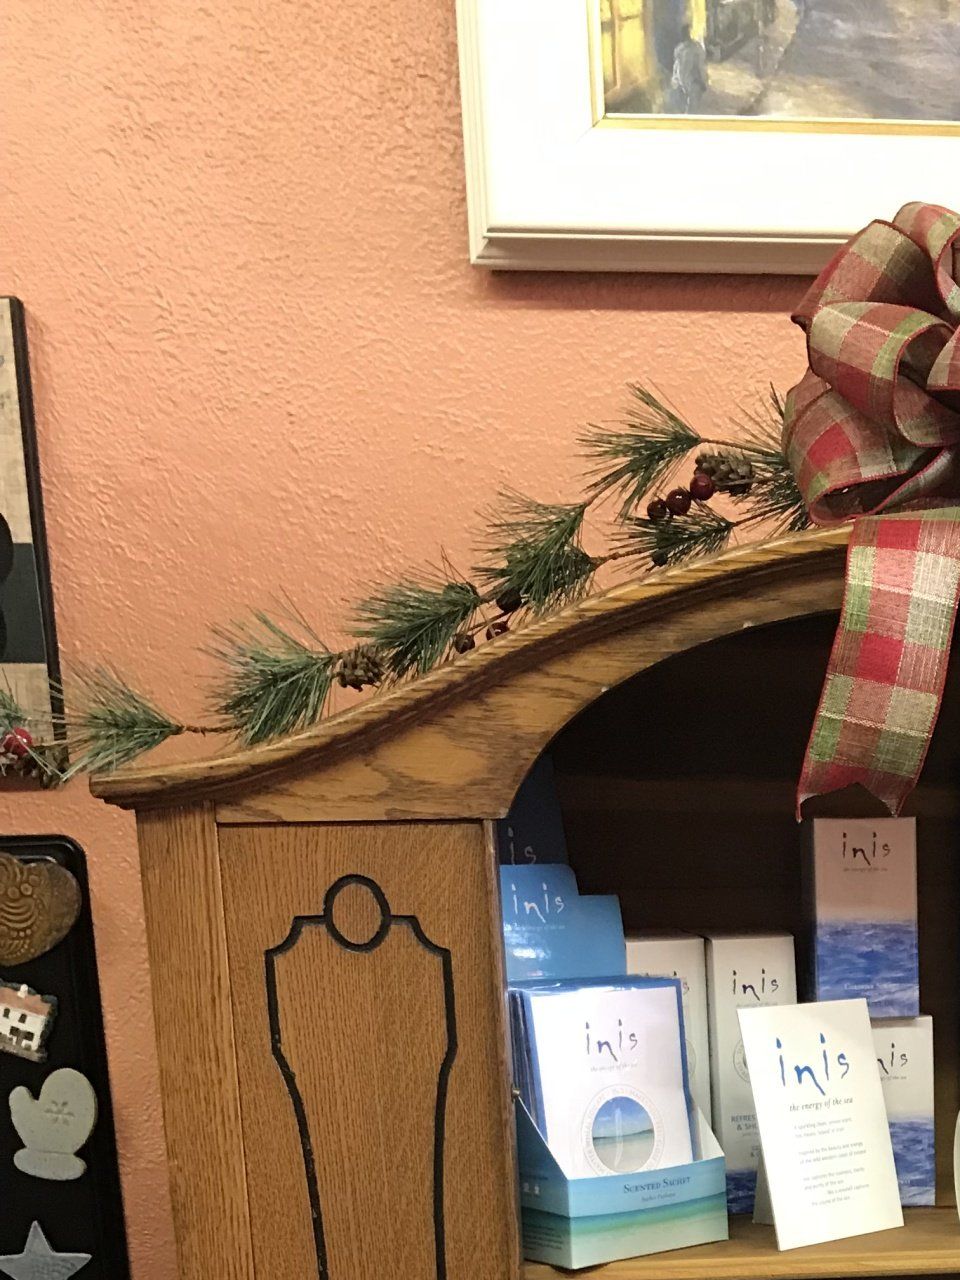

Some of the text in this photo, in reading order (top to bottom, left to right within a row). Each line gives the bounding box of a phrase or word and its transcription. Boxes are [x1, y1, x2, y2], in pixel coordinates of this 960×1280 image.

[842, 831, 891, 866] inis
[511, 882, 565, 923] inis
[732, 968, 779, 1001] inis
[585, 1019, 638, 1062] inis
[776, 1032, 850, 1096] inis
[789, 1103, 800, 1112] the
[802, 1102, 823, 1112] energy
[824, 1098, 831, 1109] of
[832, 1097, 842, 1106] the
